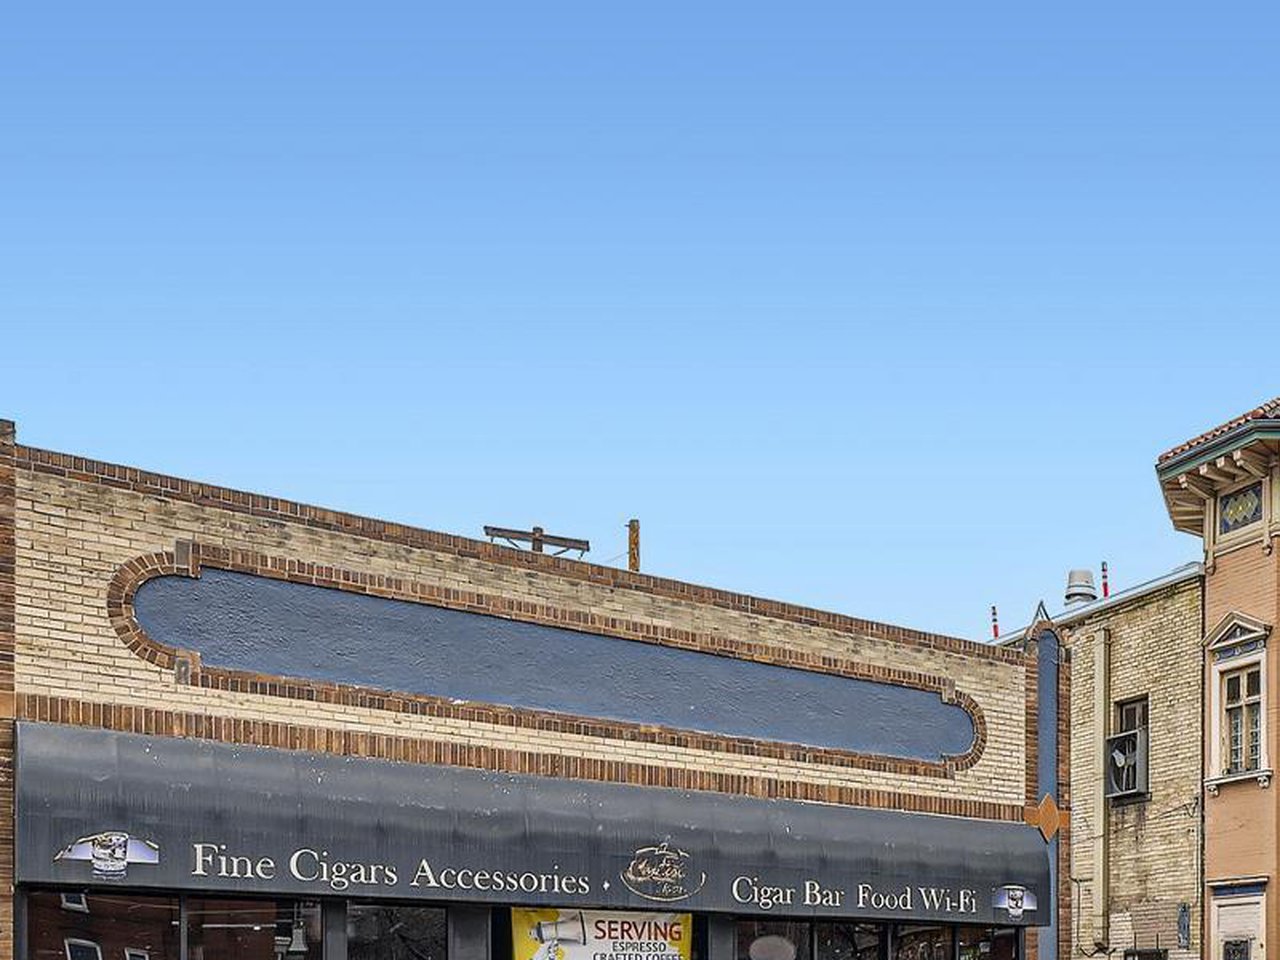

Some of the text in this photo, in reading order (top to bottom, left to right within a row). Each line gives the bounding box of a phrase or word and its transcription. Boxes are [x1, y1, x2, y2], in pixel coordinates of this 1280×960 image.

[191, 843, 275, 879] Fine
[289, 848, 398, 891] Cigars
[409, 858, 590, 895] Accessories
[732, 876, 977, 913] Cigar Bar Food Wi-Fi
[594, 919, 682, 942] SERVING
[612, 941, 667, 953] ESPRESSO
